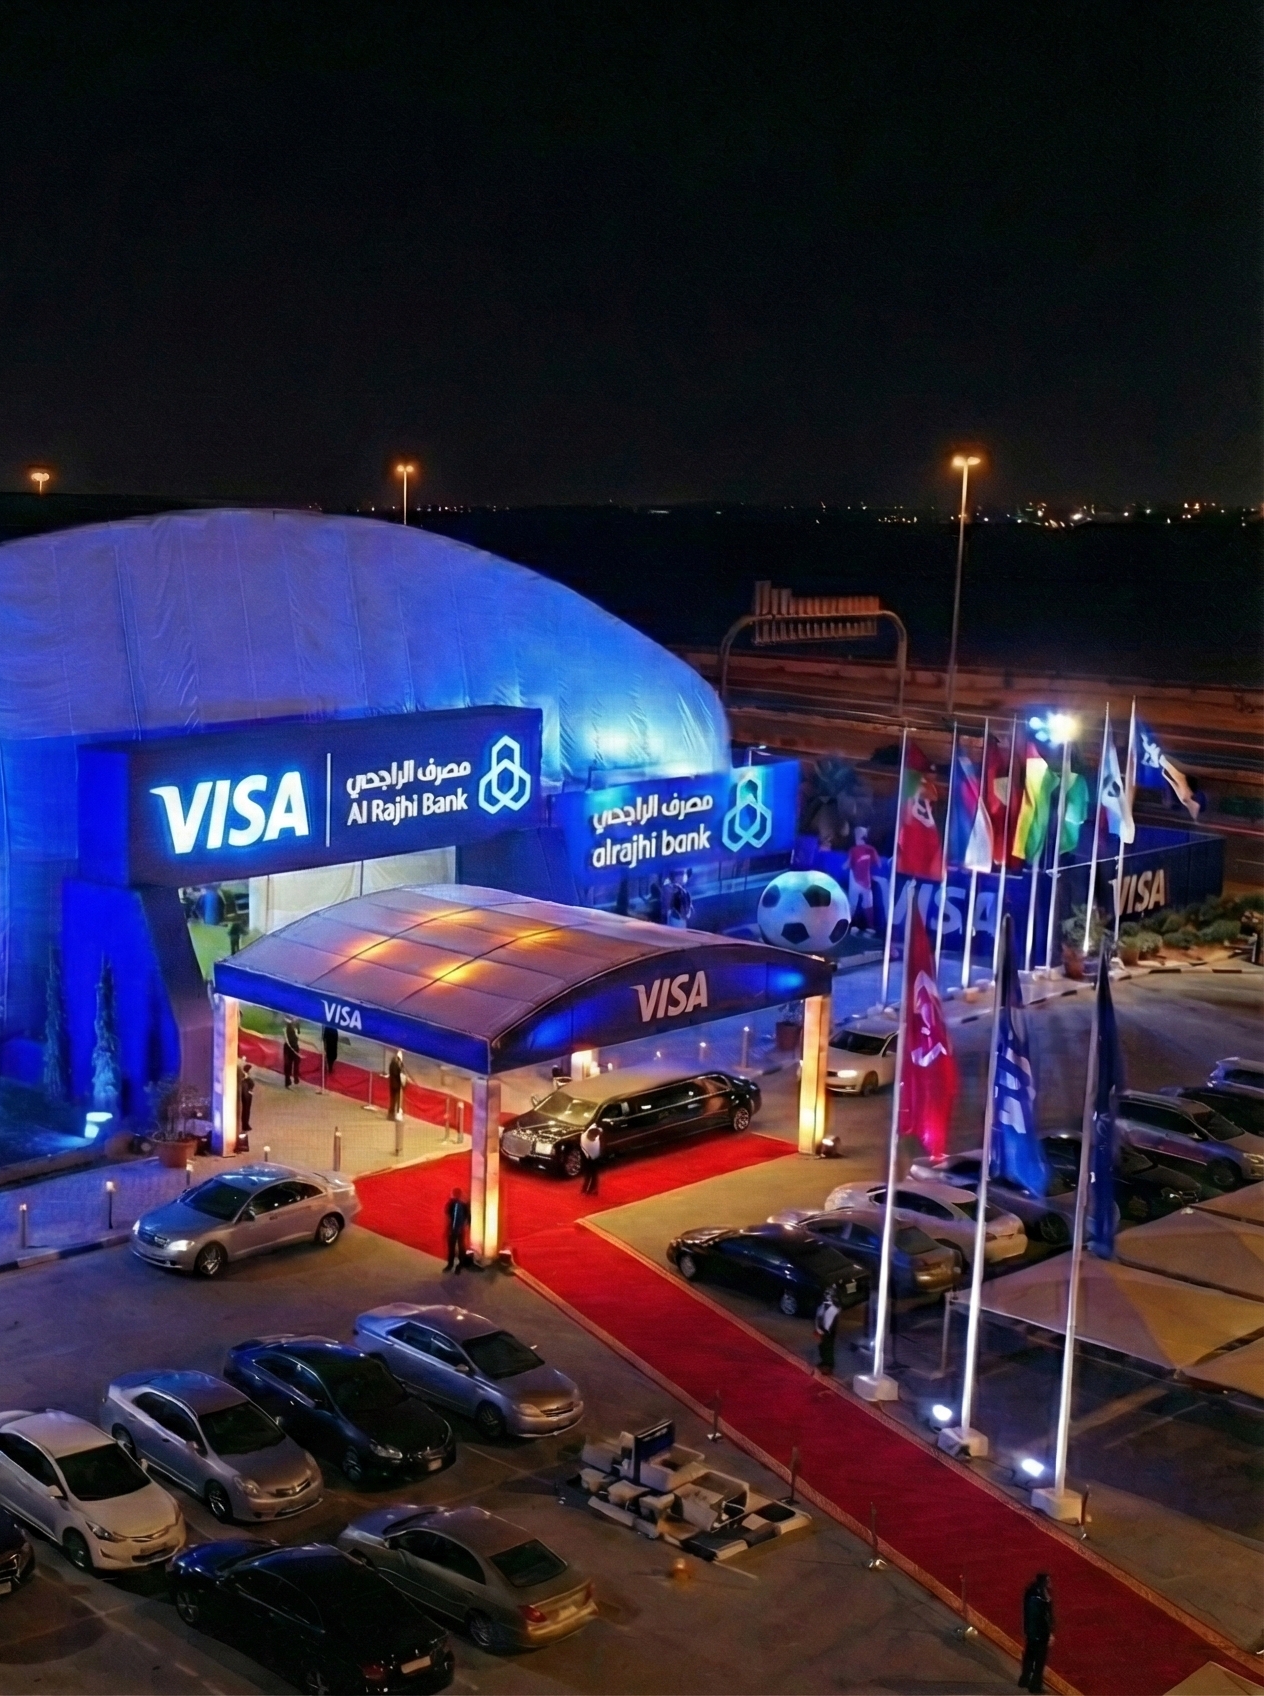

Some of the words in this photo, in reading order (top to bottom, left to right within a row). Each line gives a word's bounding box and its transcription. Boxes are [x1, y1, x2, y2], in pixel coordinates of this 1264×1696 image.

[345, 759, 415, 799] الراجحي
[416, 757, 472, 784] مصرف
[149, 771, 310, 855] VISA
[346, 800, 368, 827] Al
[371, 793, 418, 827] Rajhi
[421, 787, 469, 817] Bank
[661, 792, 714, 821] مصرف
[592, 831, 658, 869] alrajhi
[661, 823, 712, 857] bank
[871, 875, 1000, 937] VISA
[1108, 868, 1166, 917] VISA
[320, 999, 363, 1031] VISA
[629, 970, 709, 1023] VISA
